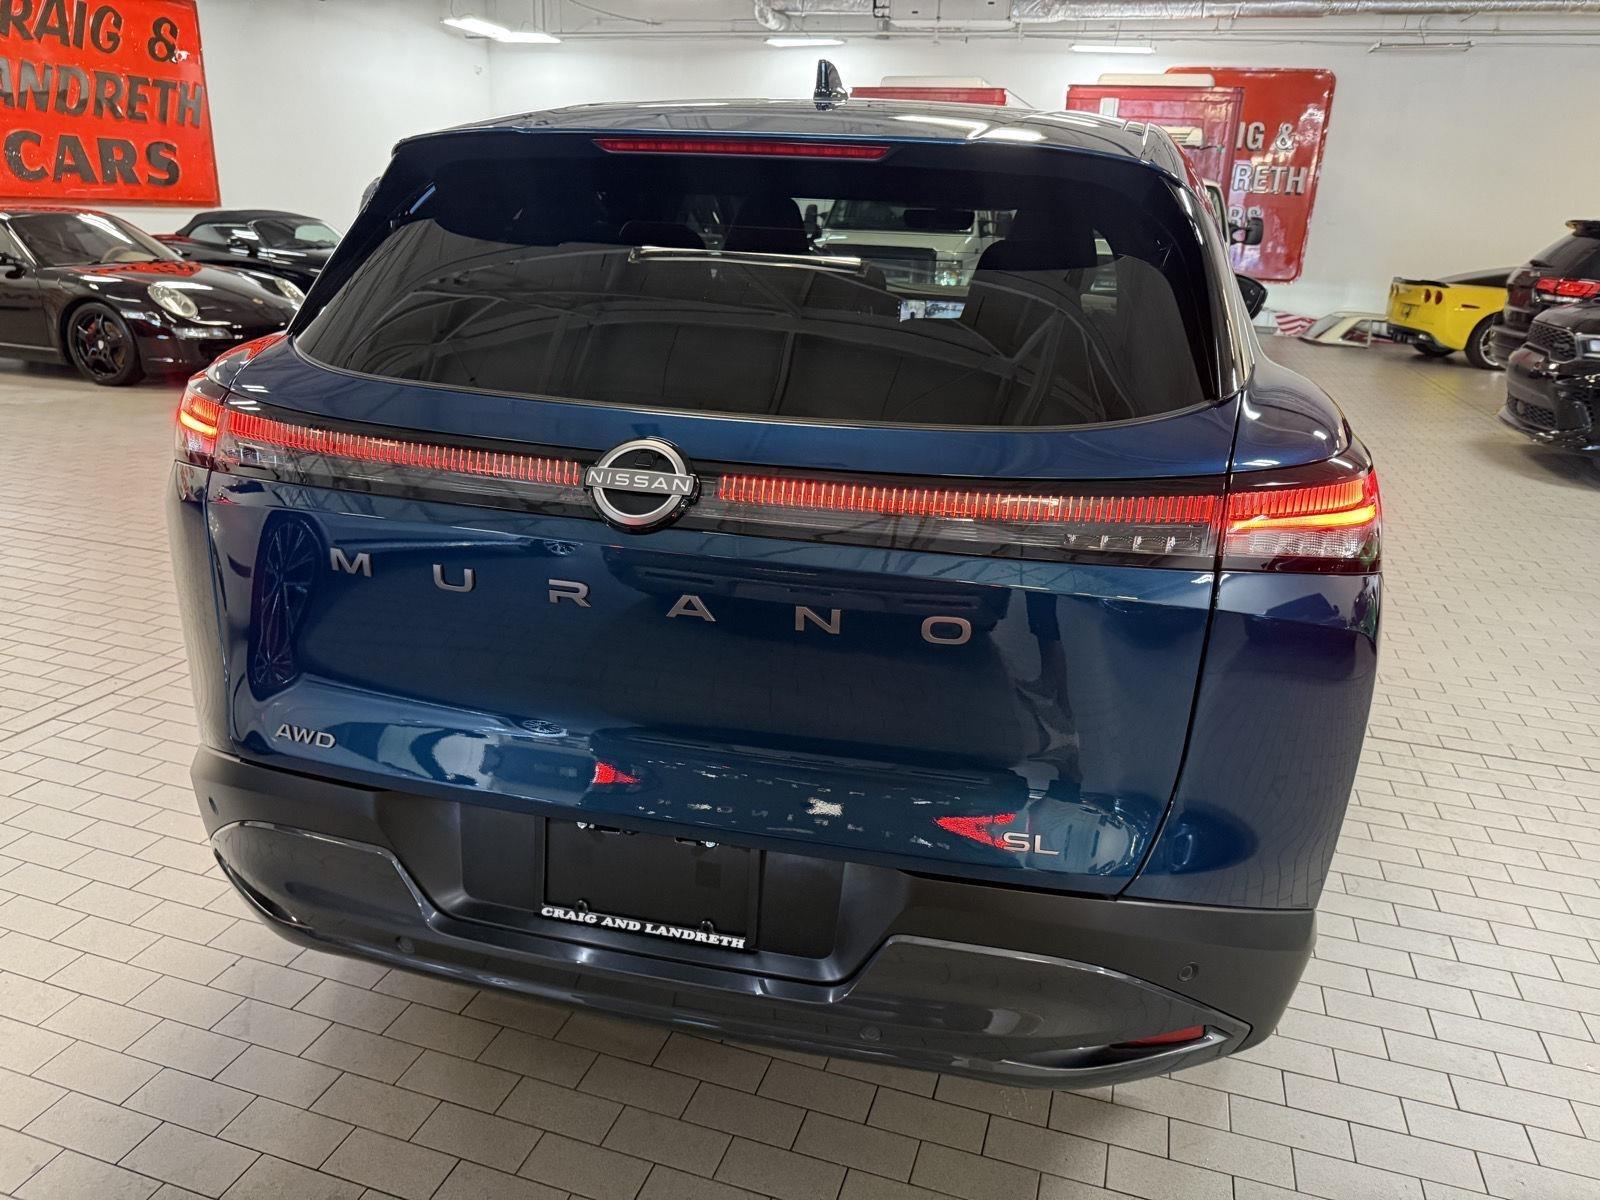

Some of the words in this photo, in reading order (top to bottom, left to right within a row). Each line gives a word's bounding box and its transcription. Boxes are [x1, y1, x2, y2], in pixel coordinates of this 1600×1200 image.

[0, 0, 123, 54] RAIG
[147, 17, 179, 63] &
[1275, 122, 1295, 150] &
[3, 130, 180, 187] CARS
[1231, 163, 1308, 195] RETH
[588, 470, 690, 492] NISSAN
[329, 547, 972, 646] MURANO
[274, 723, 337, 749] AWD
[1003, 832, 1060, 855] SL
[541, 906, 598, 924] CRAIG
[601, 916, 641, 932] AND
[644, 923, 746, 949] LANDRETH
